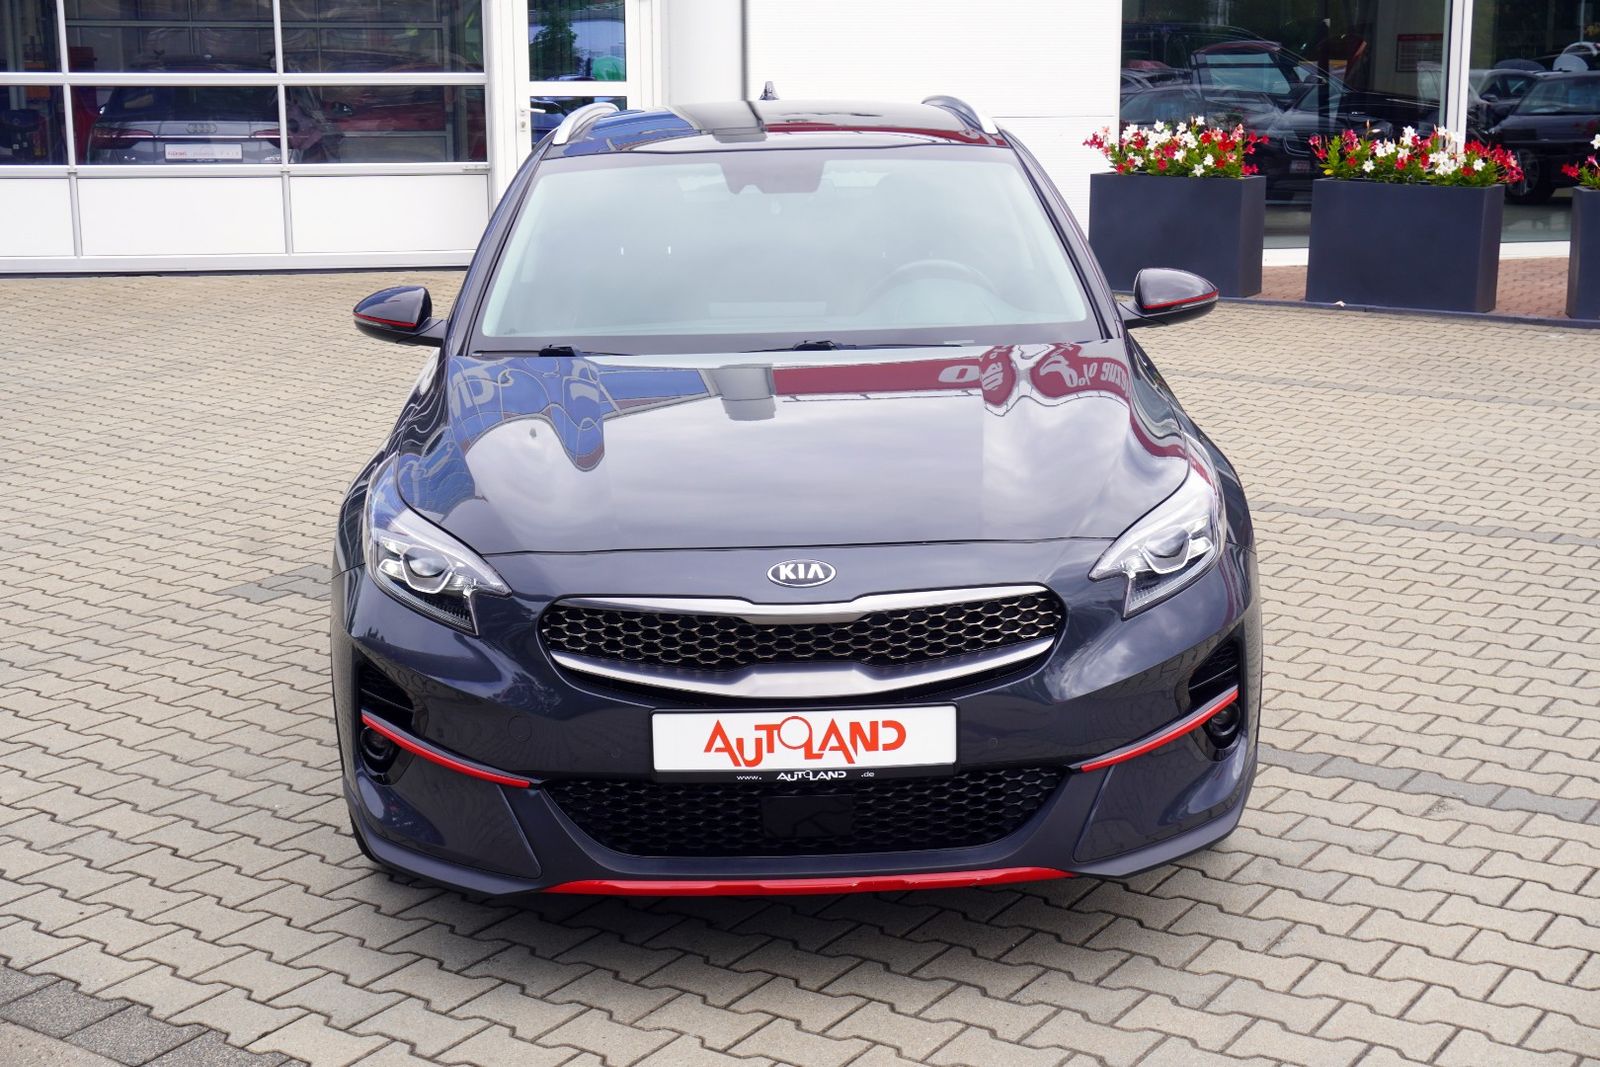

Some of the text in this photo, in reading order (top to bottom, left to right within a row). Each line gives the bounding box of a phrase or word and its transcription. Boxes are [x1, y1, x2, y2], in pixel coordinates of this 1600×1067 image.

[779, 563, 825, 580] KIA
[704, 715, 907, 768] AUTOLAND
[776, 769, 847, 782] AUTOLAND
